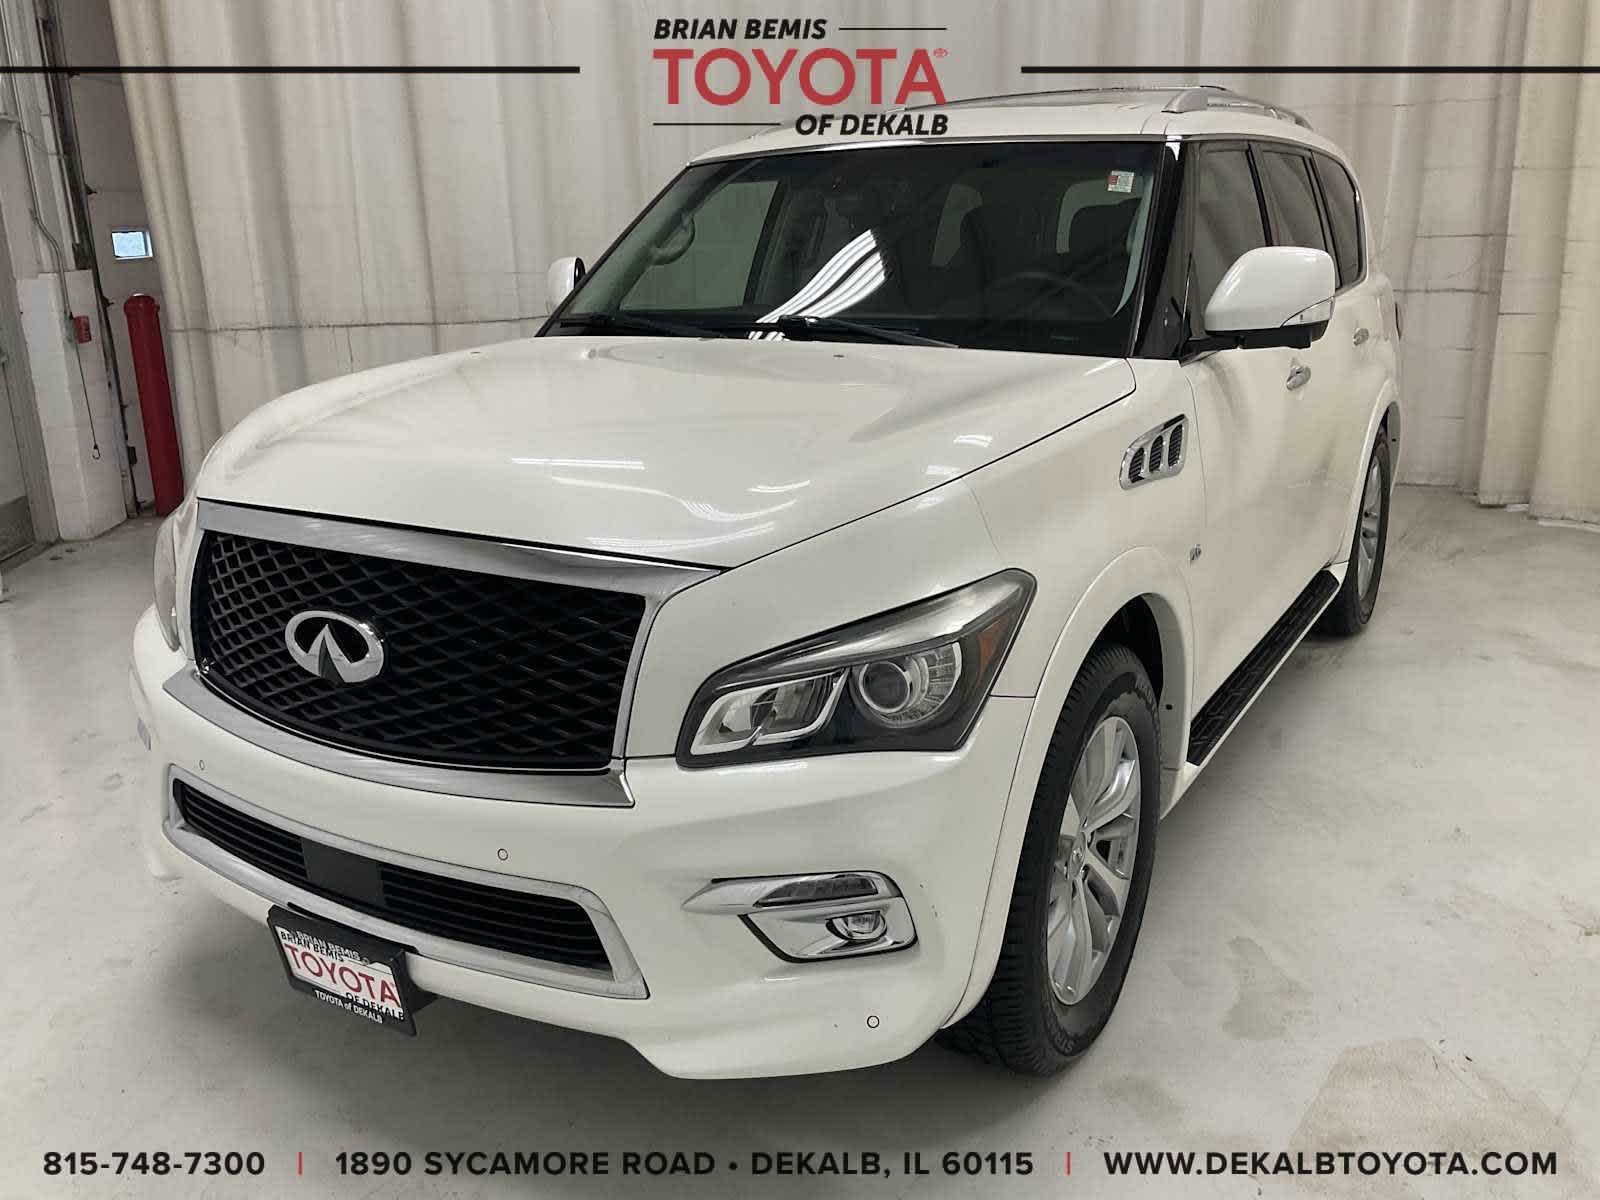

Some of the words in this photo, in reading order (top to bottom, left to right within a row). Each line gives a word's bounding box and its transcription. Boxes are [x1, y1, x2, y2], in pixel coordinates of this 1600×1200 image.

[284, 943, 401, 1008] TOYOTA
[314, 989, 344, 1008] TOYOTA
[353, 1004, 383, 1024] DEKALB
